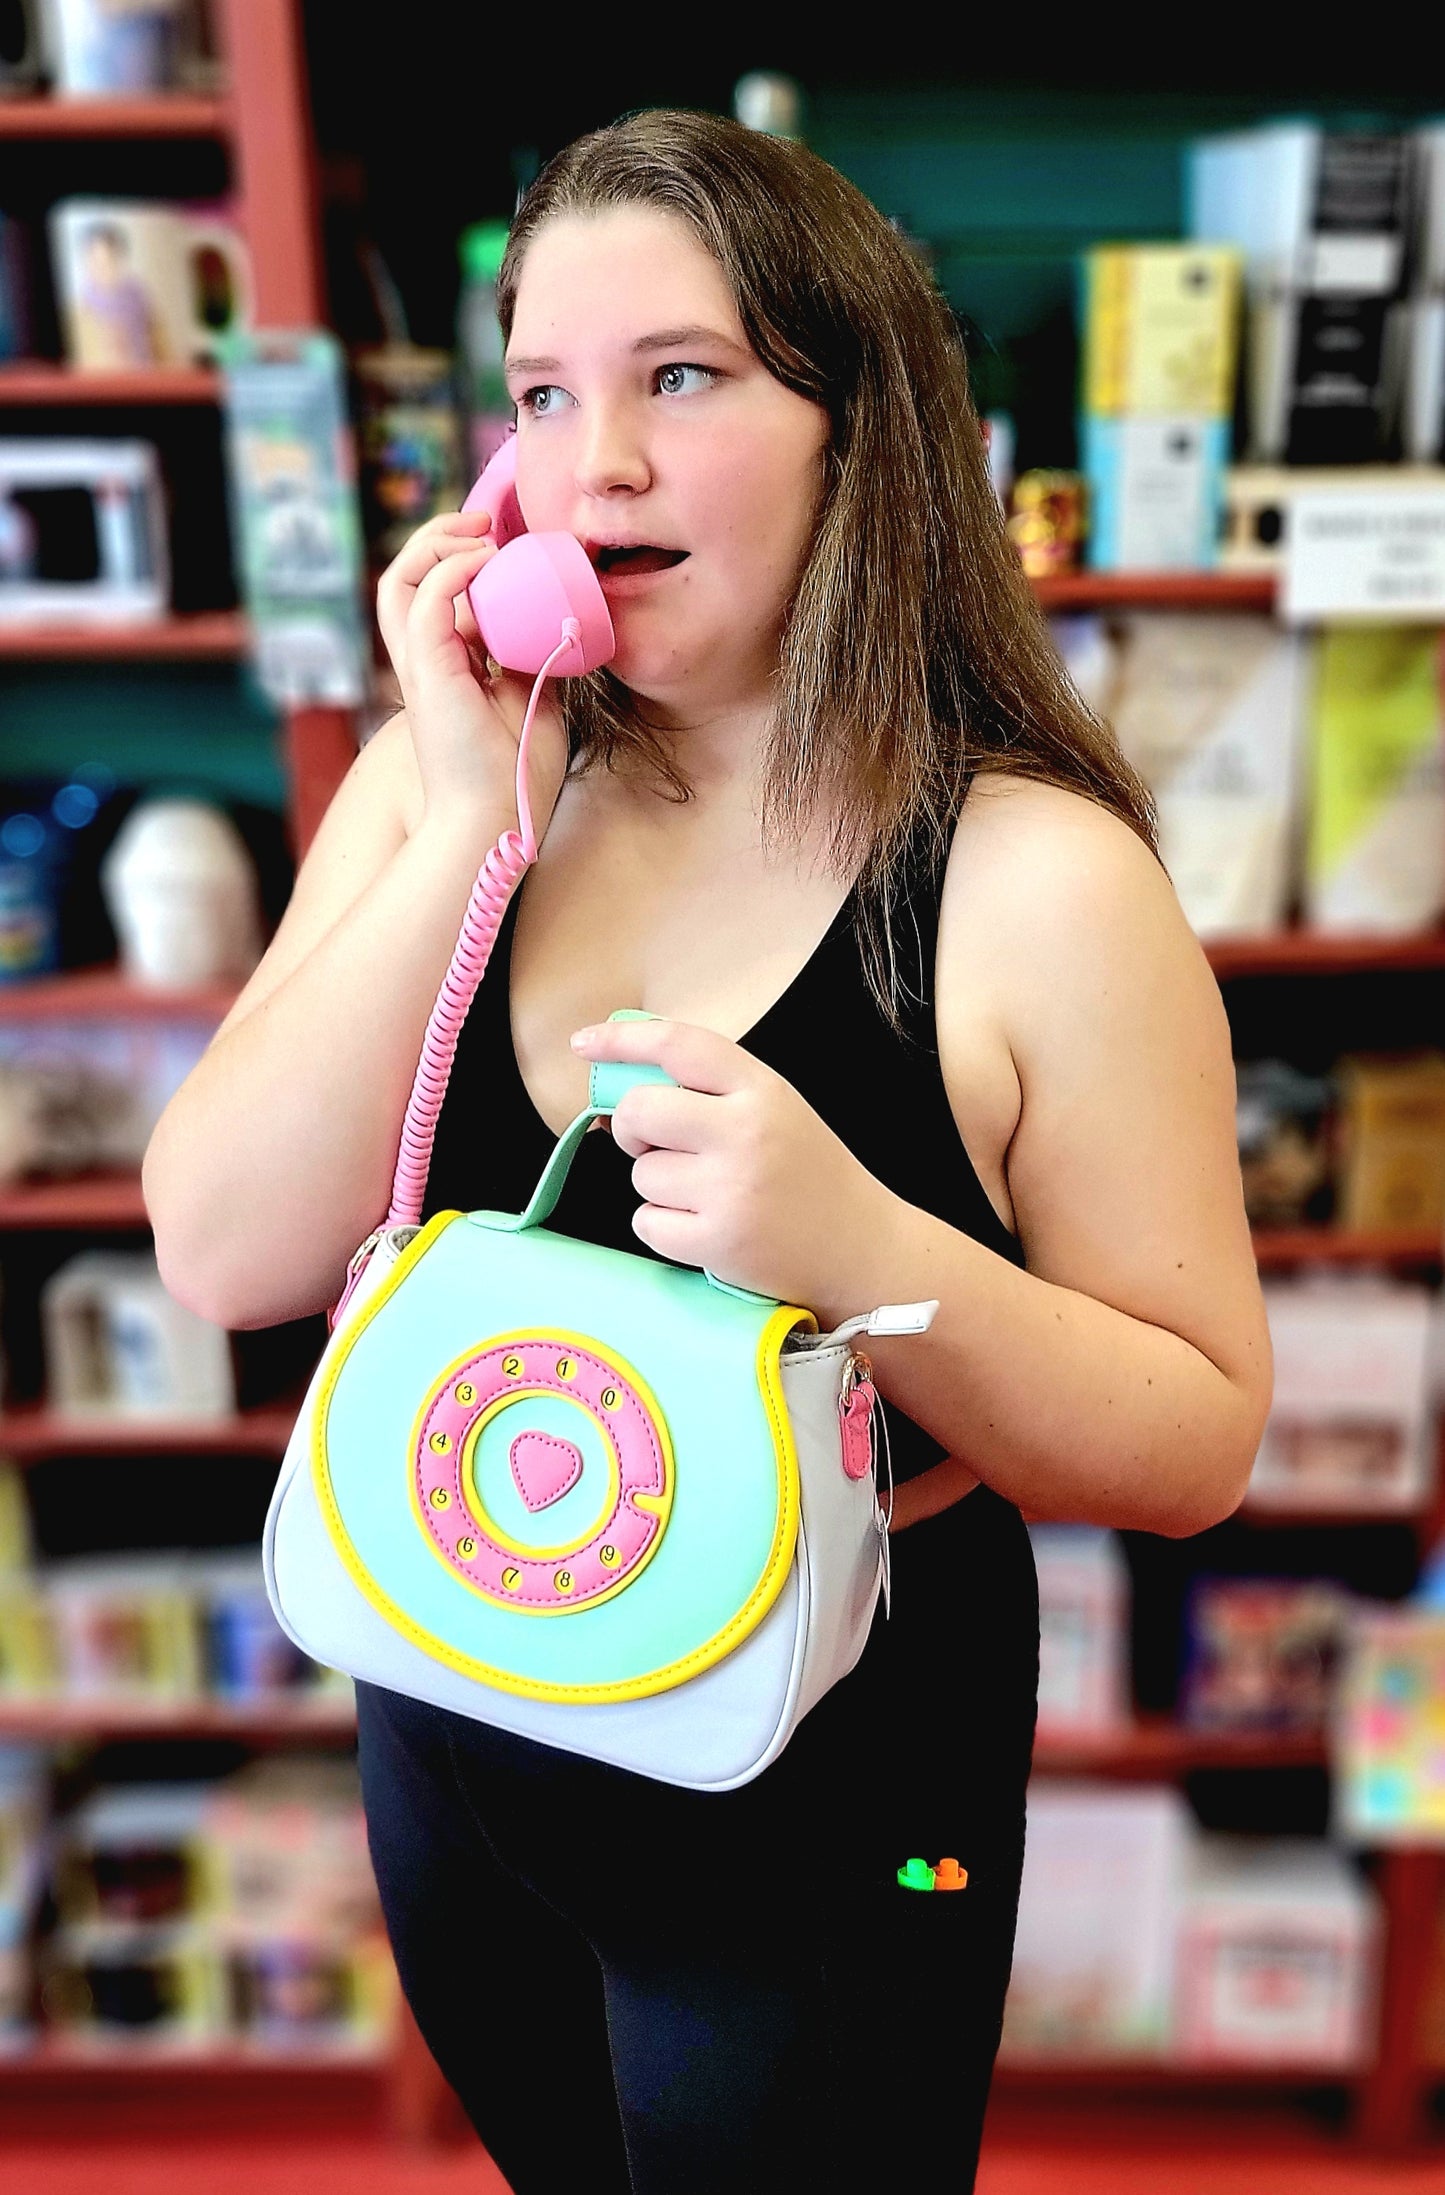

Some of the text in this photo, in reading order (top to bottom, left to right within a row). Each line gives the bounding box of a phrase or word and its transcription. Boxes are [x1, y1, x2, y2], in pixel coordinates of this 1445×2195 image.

[506, 1359, 519, 1376] 2
[560, 1360, 569, 1376] 1
[461, 1385, 473, 1401] 3
[604, 1390, 616, 1406] 0
[436, 1433, 447, 1448] 4
[437, 1488, 448, 1504] 5
[463, 1537, 474, 1553] 6
[604, 1545, 615, 1561] 9
[508, 1568, 520, 1584] 7
[560, 1571, 571, 1587] 8
